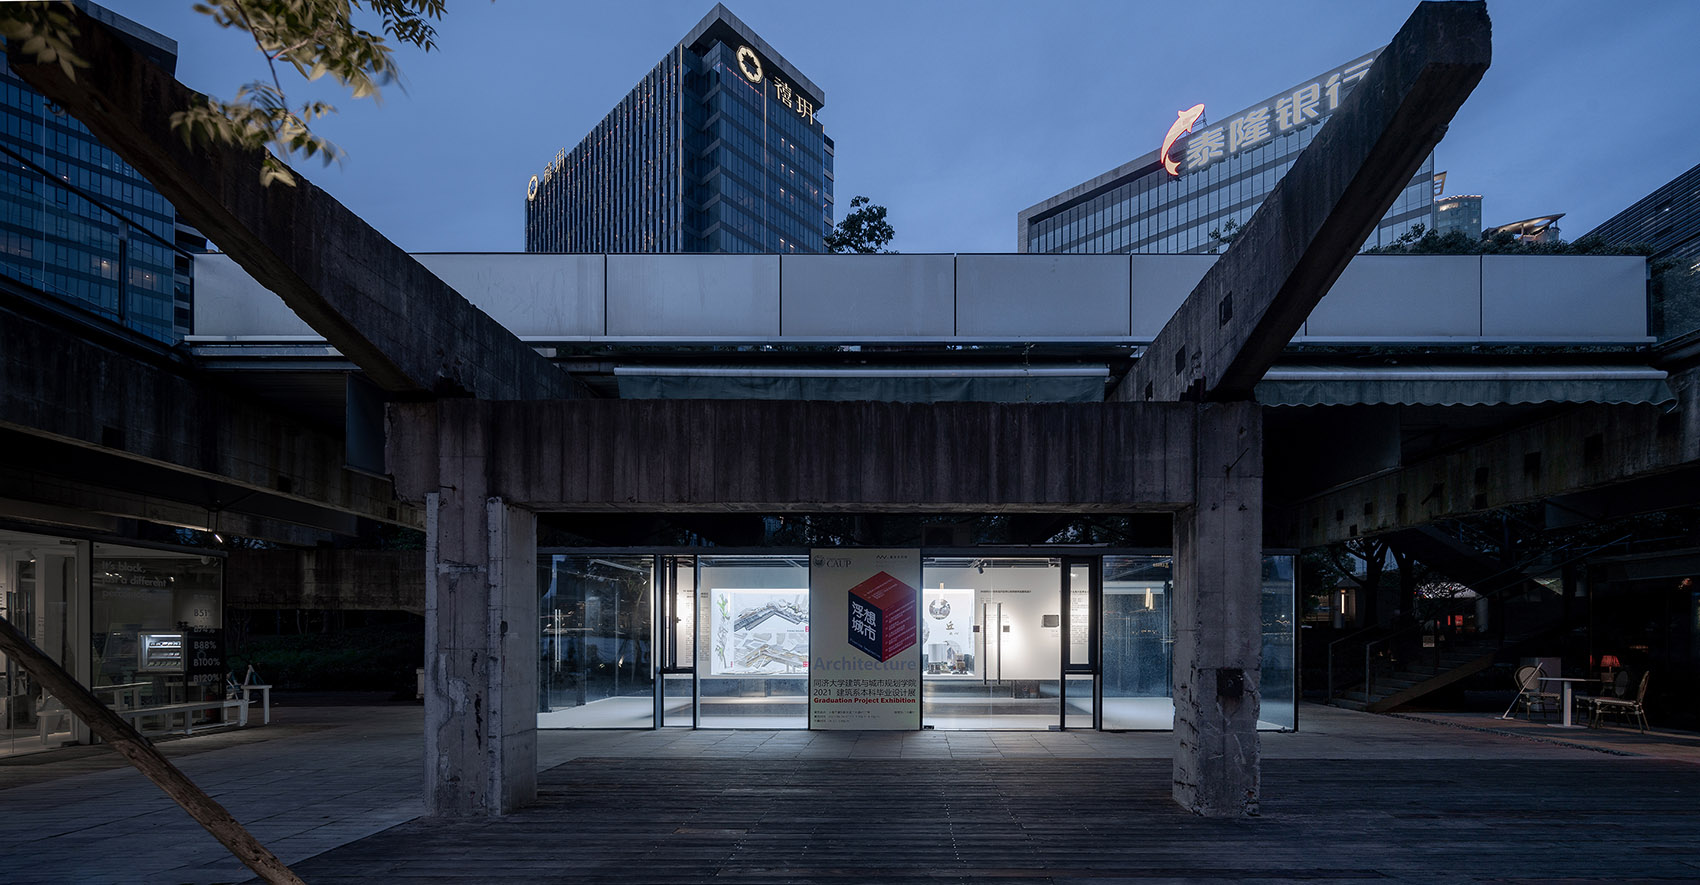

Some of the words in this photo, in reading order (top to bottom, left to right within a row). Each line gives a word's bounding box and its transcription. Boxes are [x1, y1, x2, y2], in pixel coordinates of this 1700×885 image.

[773, 75, 814, 126] 禧玥
[118, 561, 146, 573] black,
[826, 559, 852, 568] CAUP
[130, 575, 167, 587] different
[851, 601, 877, 627] 浮想
[851, 617, 877, 642] 城市
[193, 641, 217, 650] B88%
[193, 658, 221, 667] B100%
[813, 656, 917, 671] Architecture
[813, 679, 917, 688] 同济大学建筑与城市规划学院
[813, 688, 832, 696] 2021
[836, 688, 916, 697] 建筑系本科毕业设计展
[854, 697, 879, 705] Project
